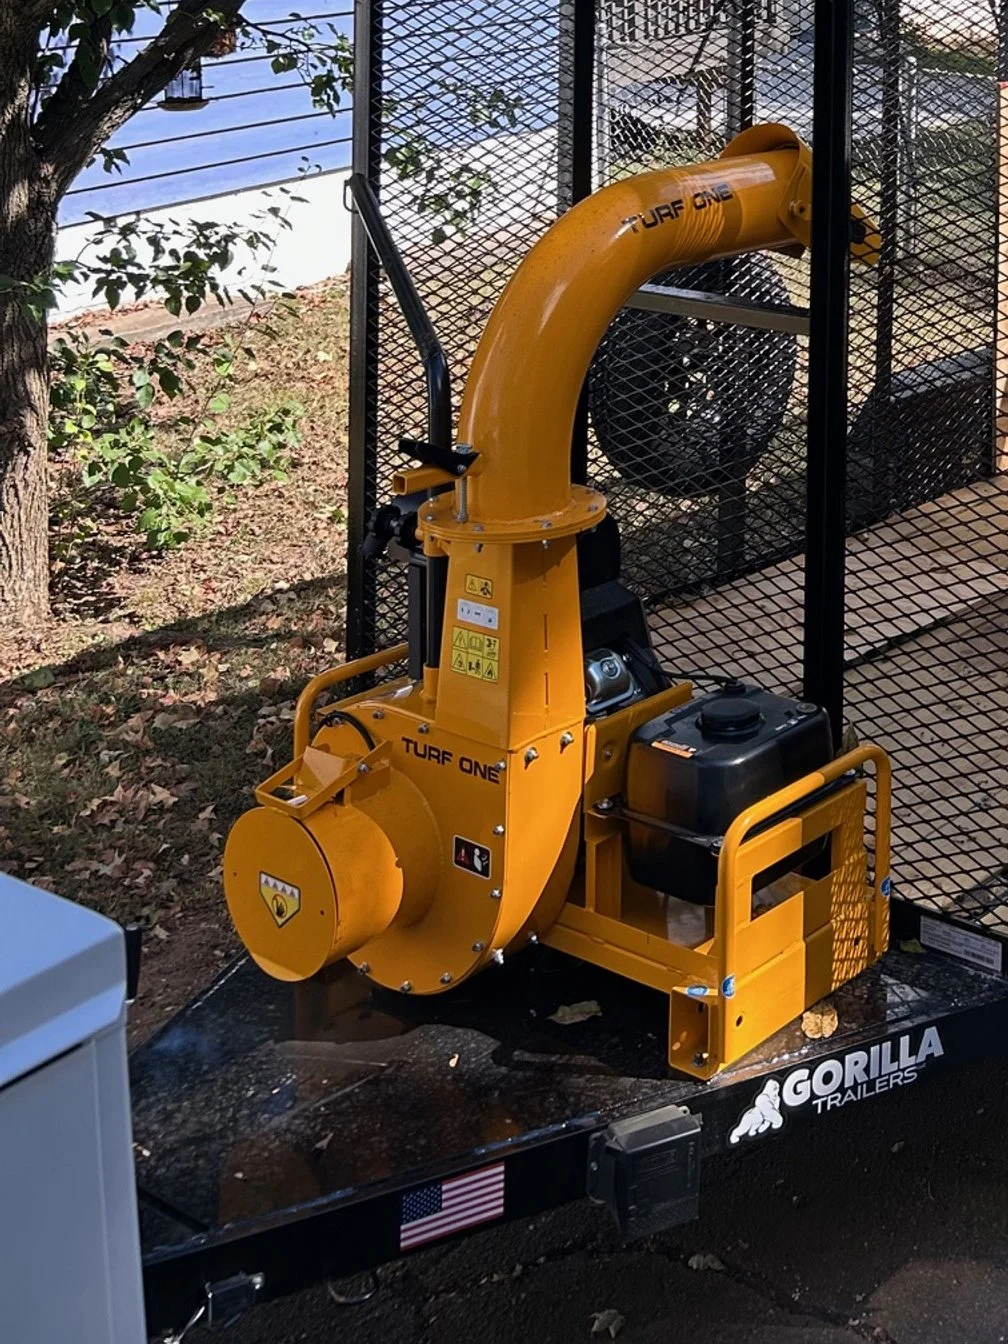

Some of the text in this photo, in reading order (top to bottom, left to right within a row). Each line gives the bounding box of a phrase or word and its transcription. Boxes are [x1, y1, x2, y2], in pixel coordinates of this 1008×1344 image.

[621, 184, 732, 233] TURF ONE
[402, 736, 500, 784] TURF ONE
[782, 1026, 944, 1106] GORILLA
[812, 1068, 918, 1114] TRAILERS
